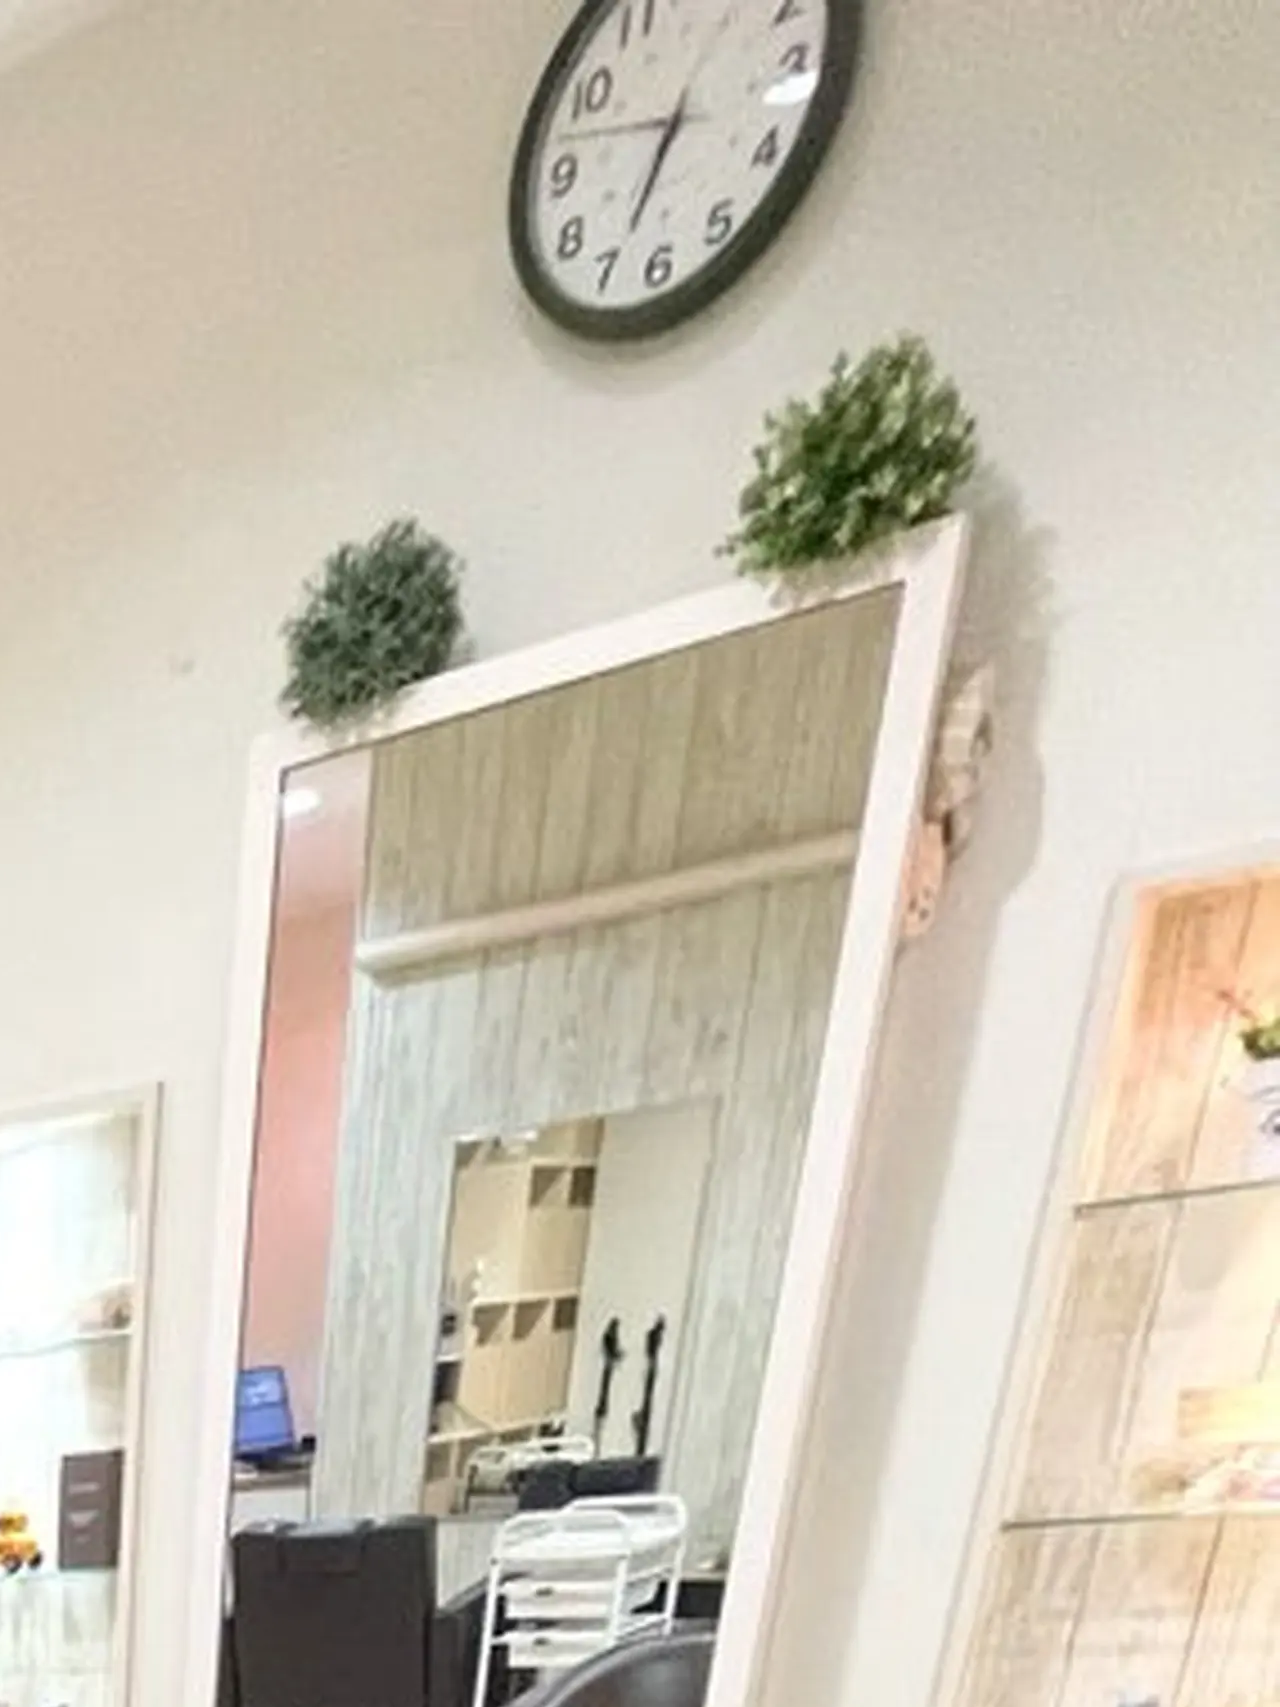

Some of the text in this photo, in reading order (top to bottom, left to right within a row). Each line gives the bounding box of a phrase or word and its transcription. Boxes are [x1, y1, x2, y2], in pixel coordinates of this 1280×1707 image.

[571, 66, 613, 120] 10
[751, 126, 779, 167] 4
[549, 152, 578, 197] 9
[557, 216, 584, 261] 8
[704, 199, 733, 246] 5
[595, 246, 621, 293] 7
[644, 246, 673, 288] 6
